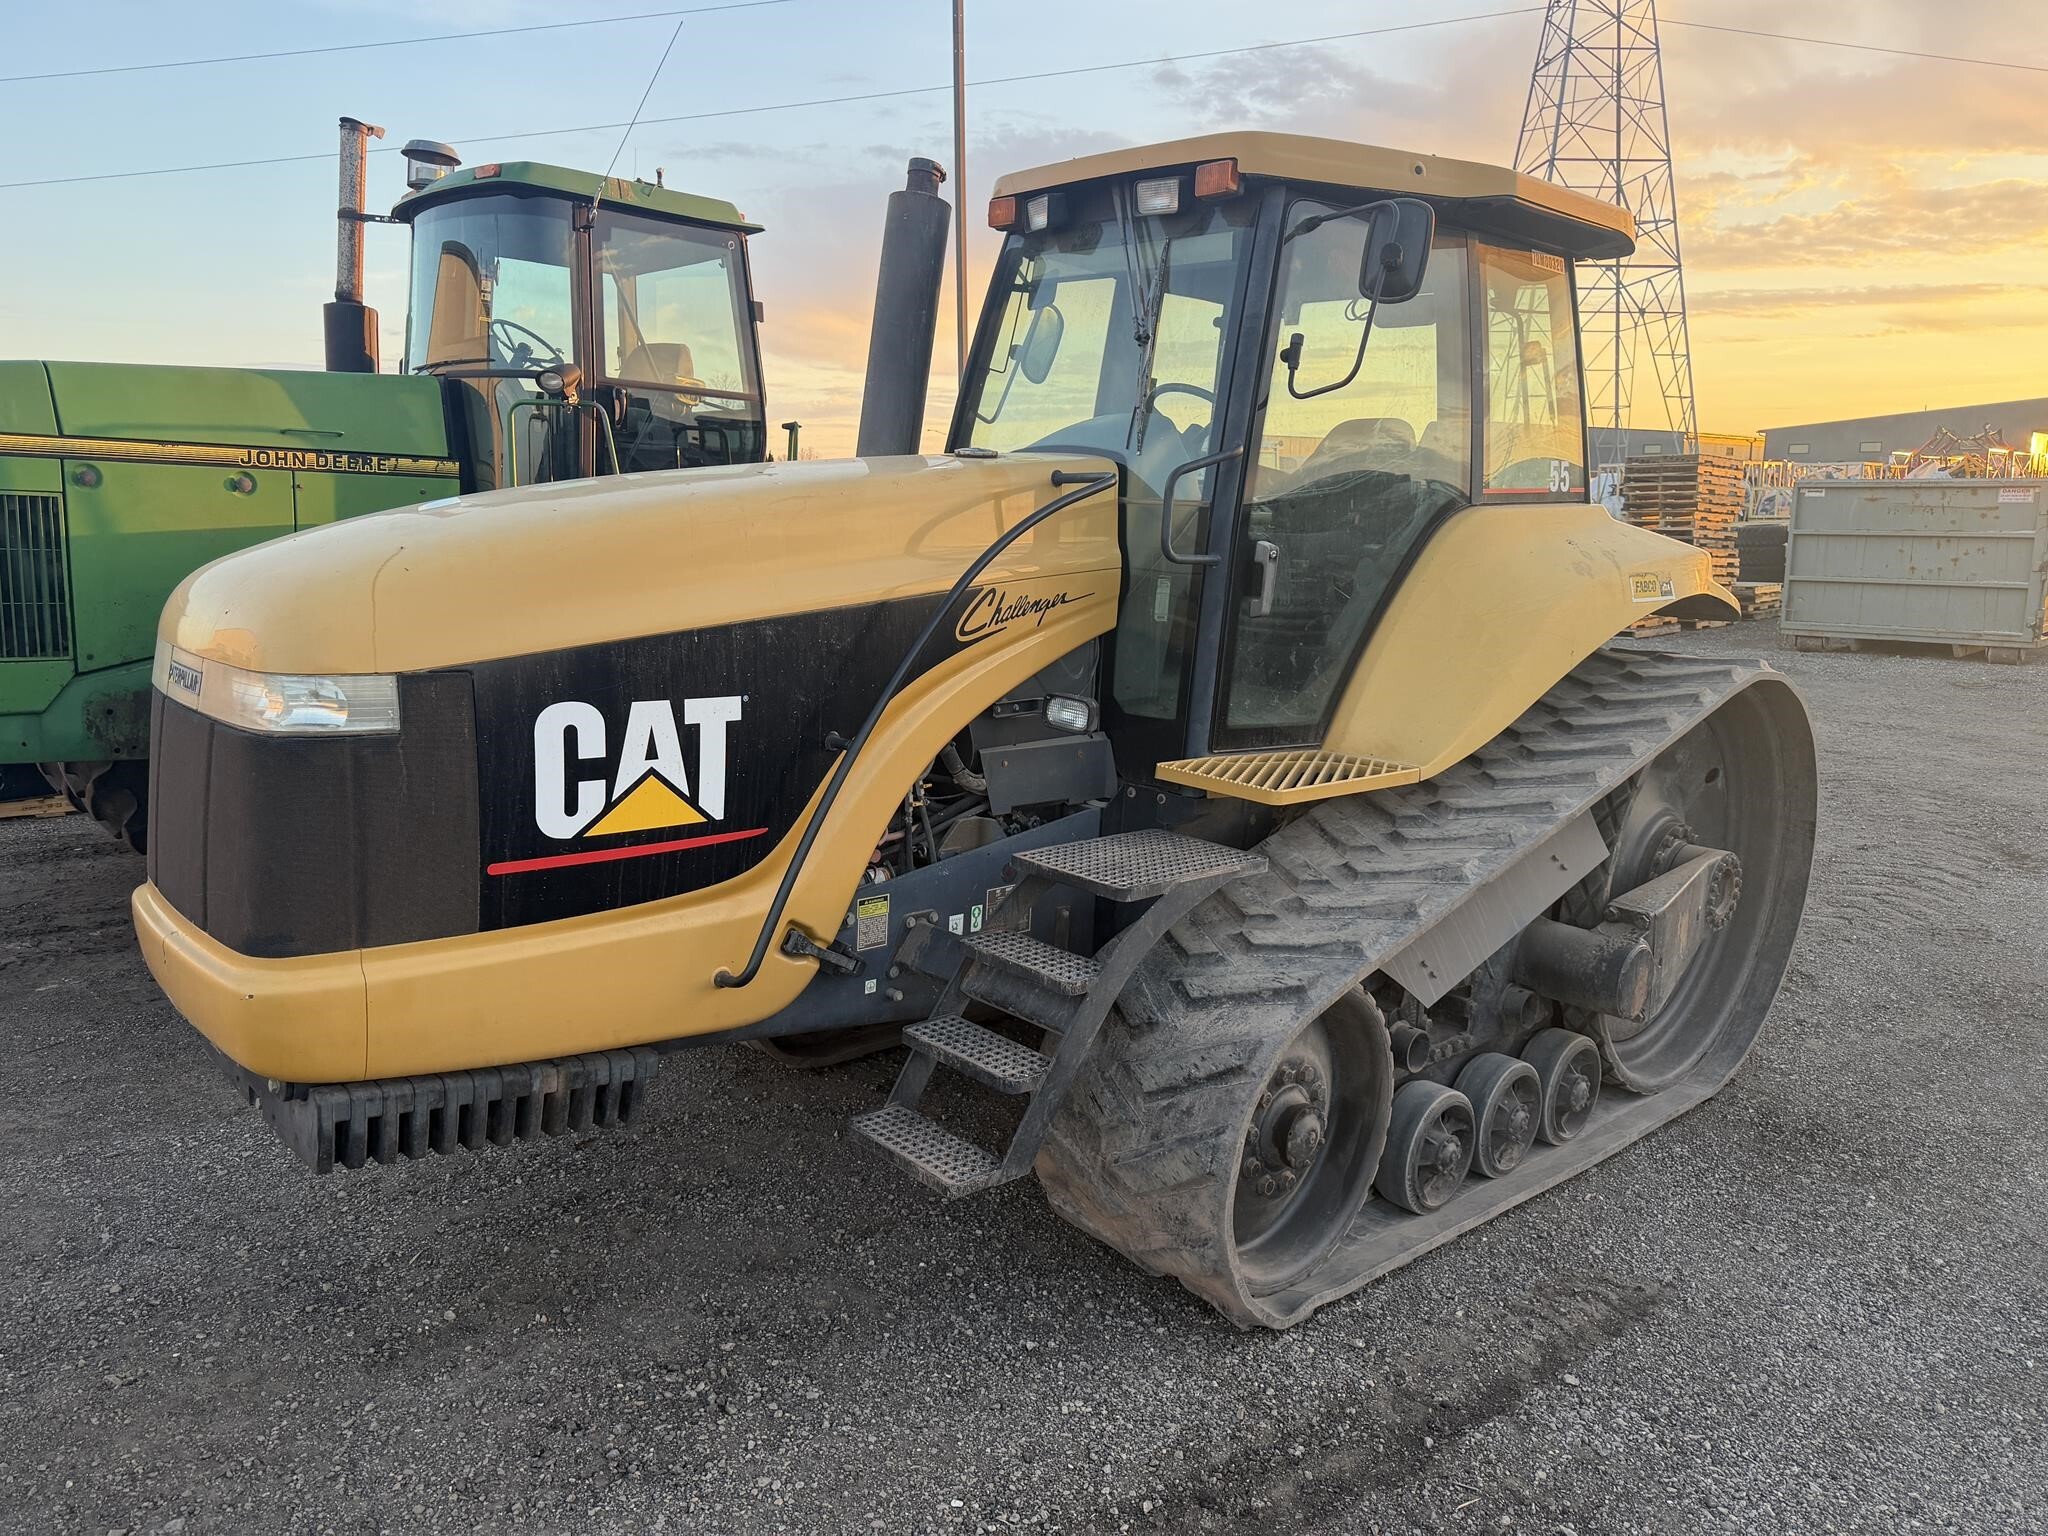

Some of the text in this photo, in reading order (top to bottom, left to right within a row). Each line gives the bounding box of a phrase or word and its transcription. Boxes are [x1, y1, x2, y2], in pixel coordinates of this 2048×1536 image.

[239, 450, 388, 473] JOHN DEERE
[1550, 460, 1570, 492] 55
[1635, 580, 1657, 593] FABCO
[956, 587, 1095, 637] Challenger
[534, 696, 742, 840] CAT
